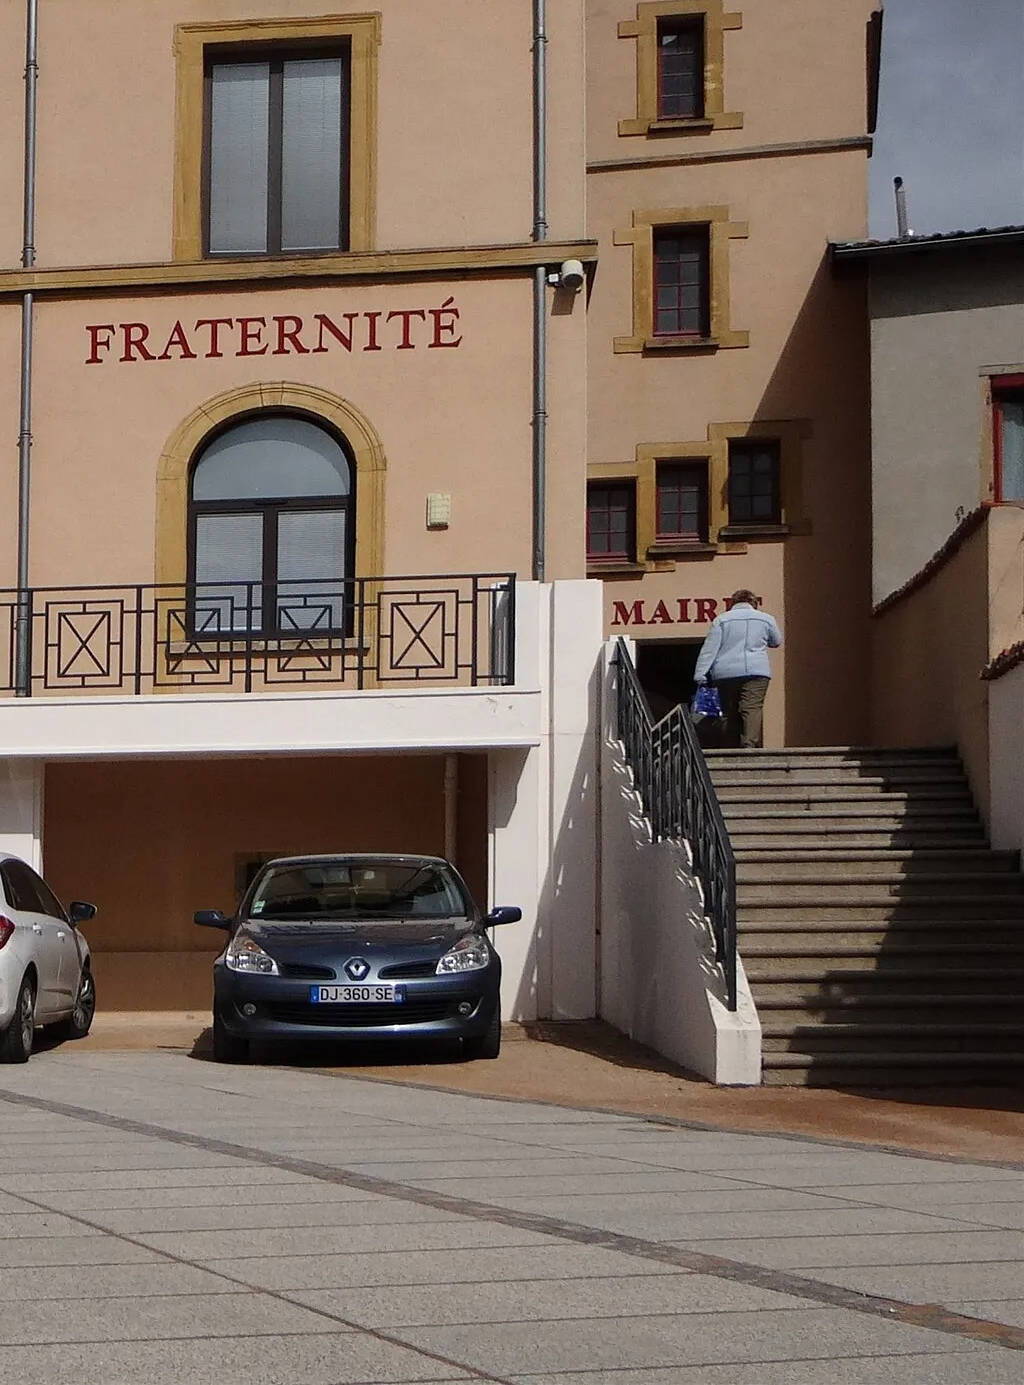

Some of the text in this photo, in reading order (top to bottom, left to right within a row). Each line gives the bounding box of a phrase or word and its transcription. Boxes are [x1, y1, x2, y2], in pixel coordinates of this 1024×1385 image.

[84, 296, 463, 364] FRATERNITÉ
[610, 596, 763, 626] MAIR
[320, 987, 393, 1001] DJ-360-SE
